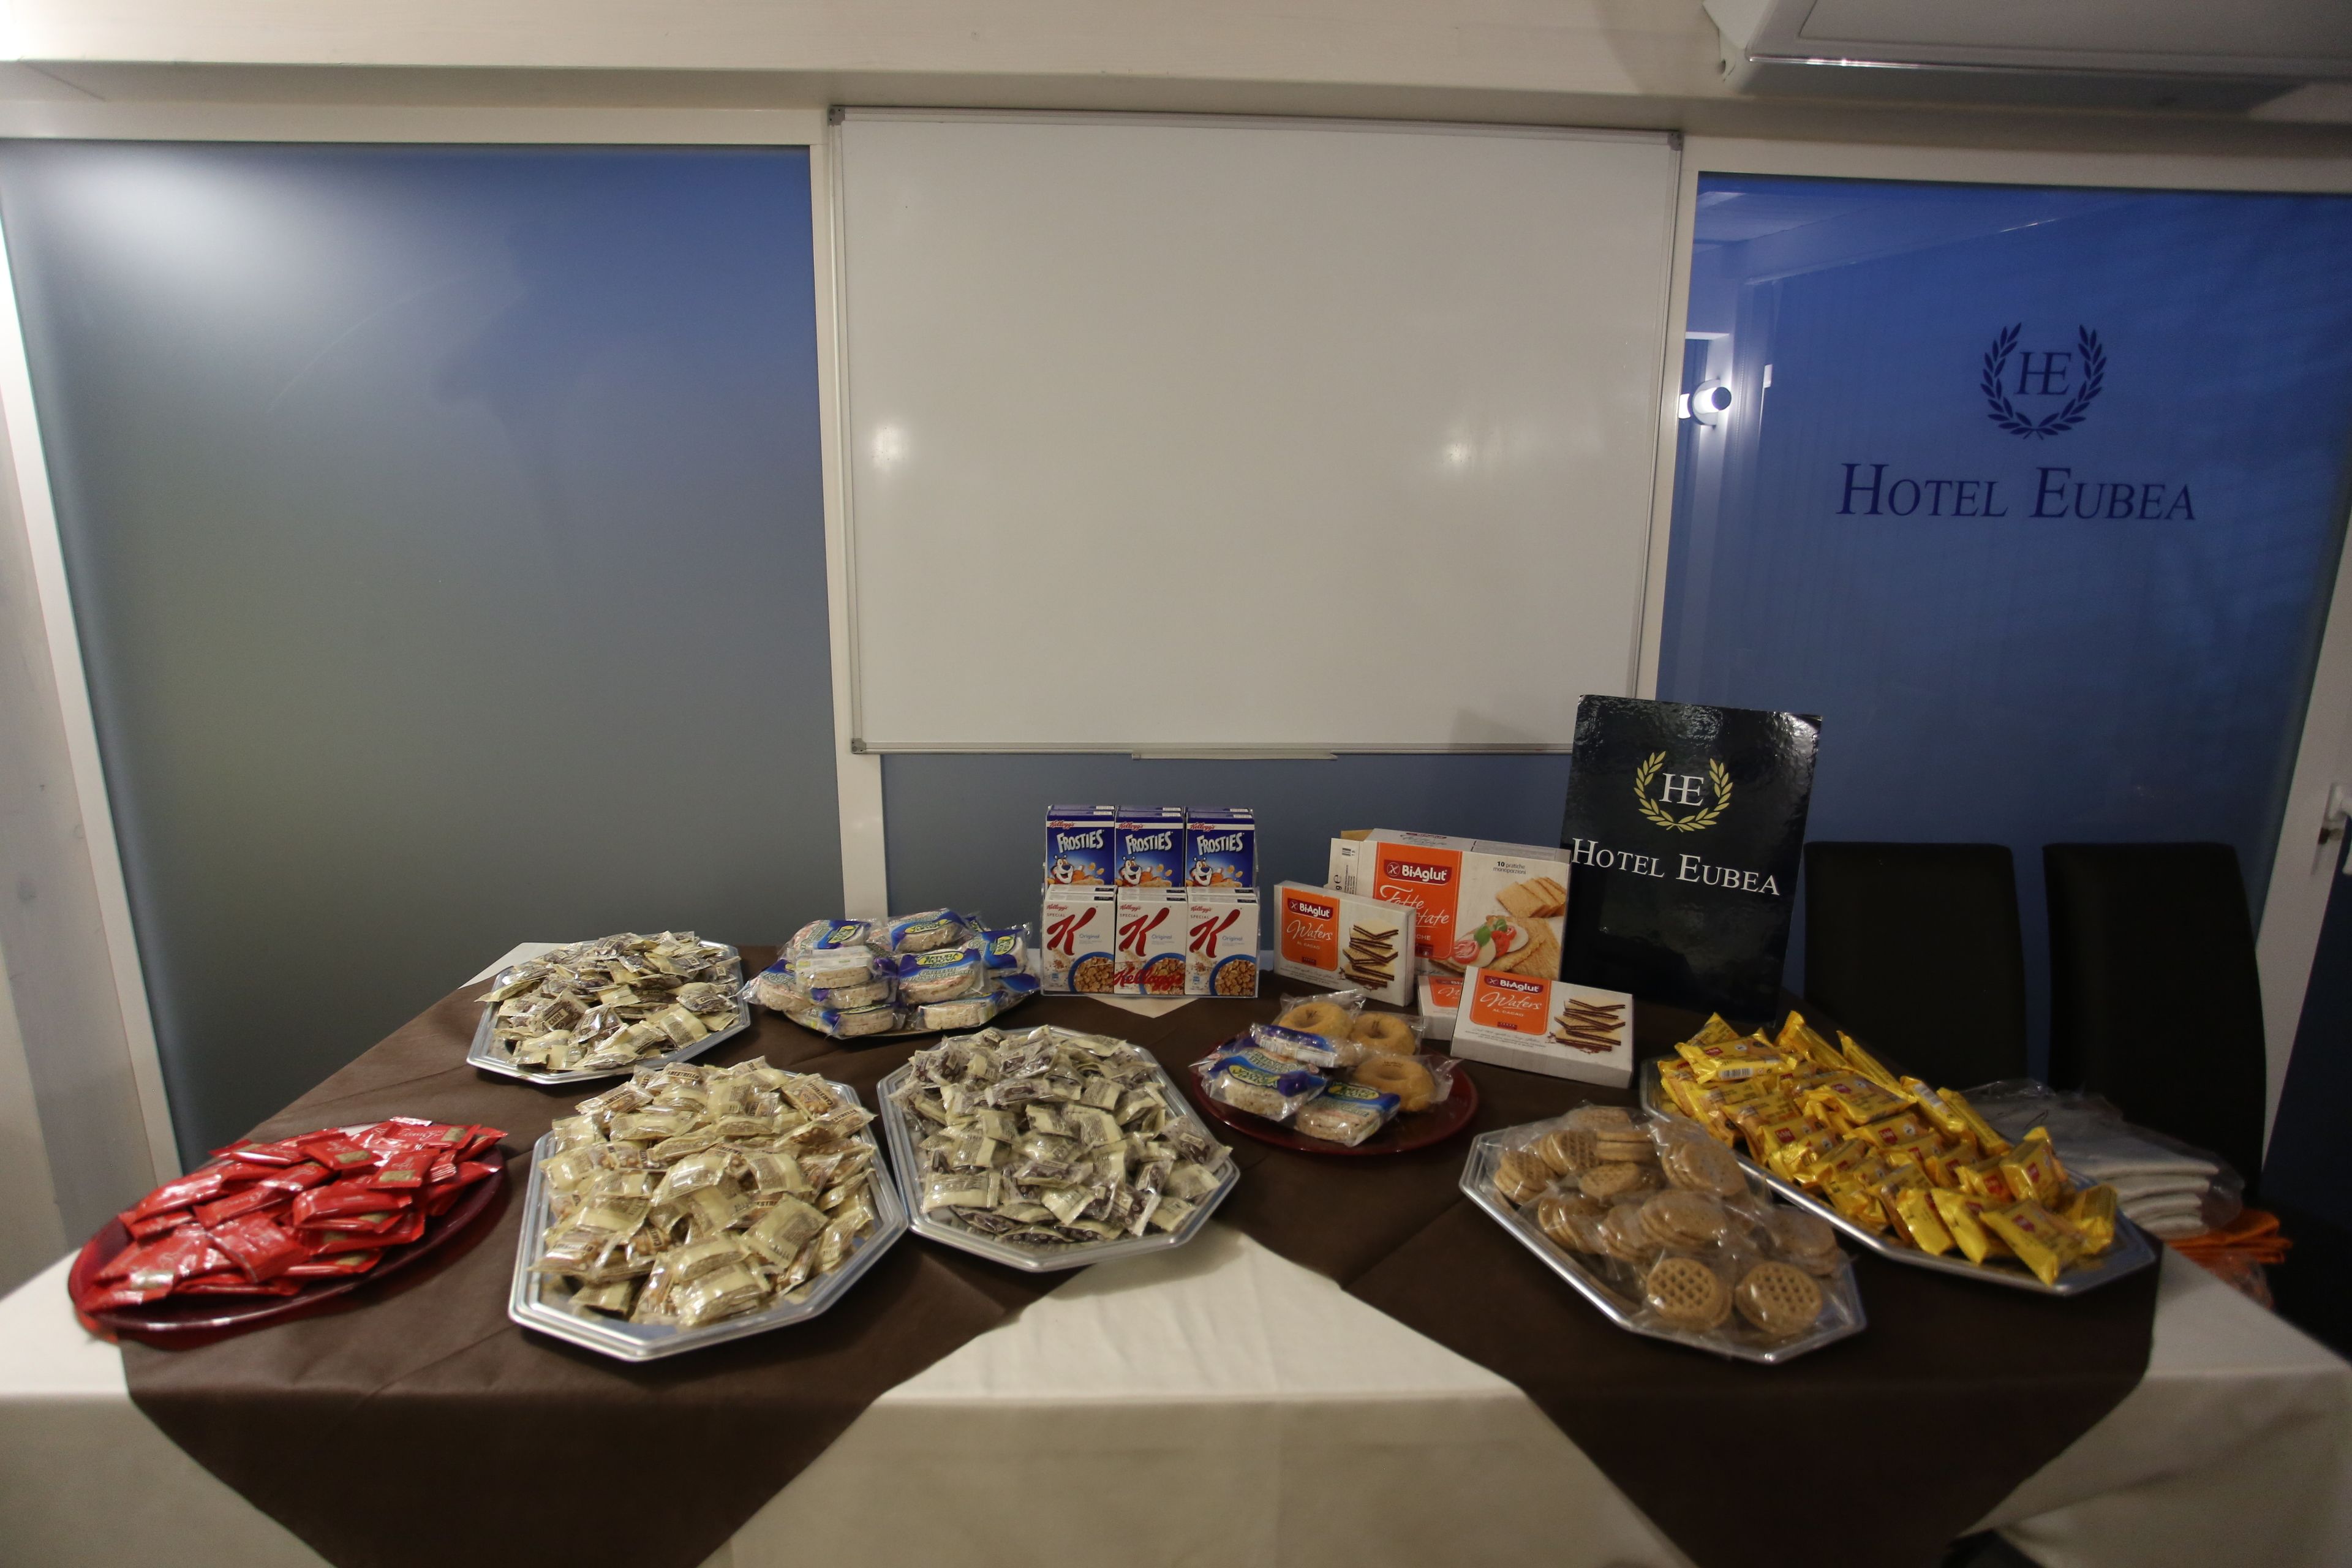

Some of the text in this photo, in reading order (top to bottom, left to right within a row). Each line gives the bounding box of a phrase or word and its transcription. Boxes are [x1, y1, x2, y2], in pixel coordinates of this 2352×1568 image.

[2013, 352, 2072, 396] HE
[1836, 463, 2196, 520] HOTEL EUBEA
[1659, 773, 1704, 807] HE
[1049, 820, 1074, 829] Kellogg's
[1118, 821, 1144, 831] Kellogg's
[1189, 823, 1215, 831] Kellogg's
[1057, 829, 1104, 853] FROSTIES
[1125, 831, 1172, 854] FROSTIES
[1197, 832, 1243, 856] FROSTIES
[1572, 837, 1780, 896] HOTEL EUBEA
[1047, 907, 1096, 956] K
[1119, 907, 1169, 956] K
[1189, 909, 1240, 958] K
[1286, 919, 1333, 940] Wafers
[1480, 992, 1542, 1010] Wafers
[548, 1012, 564, 1026] CAFFÈ
